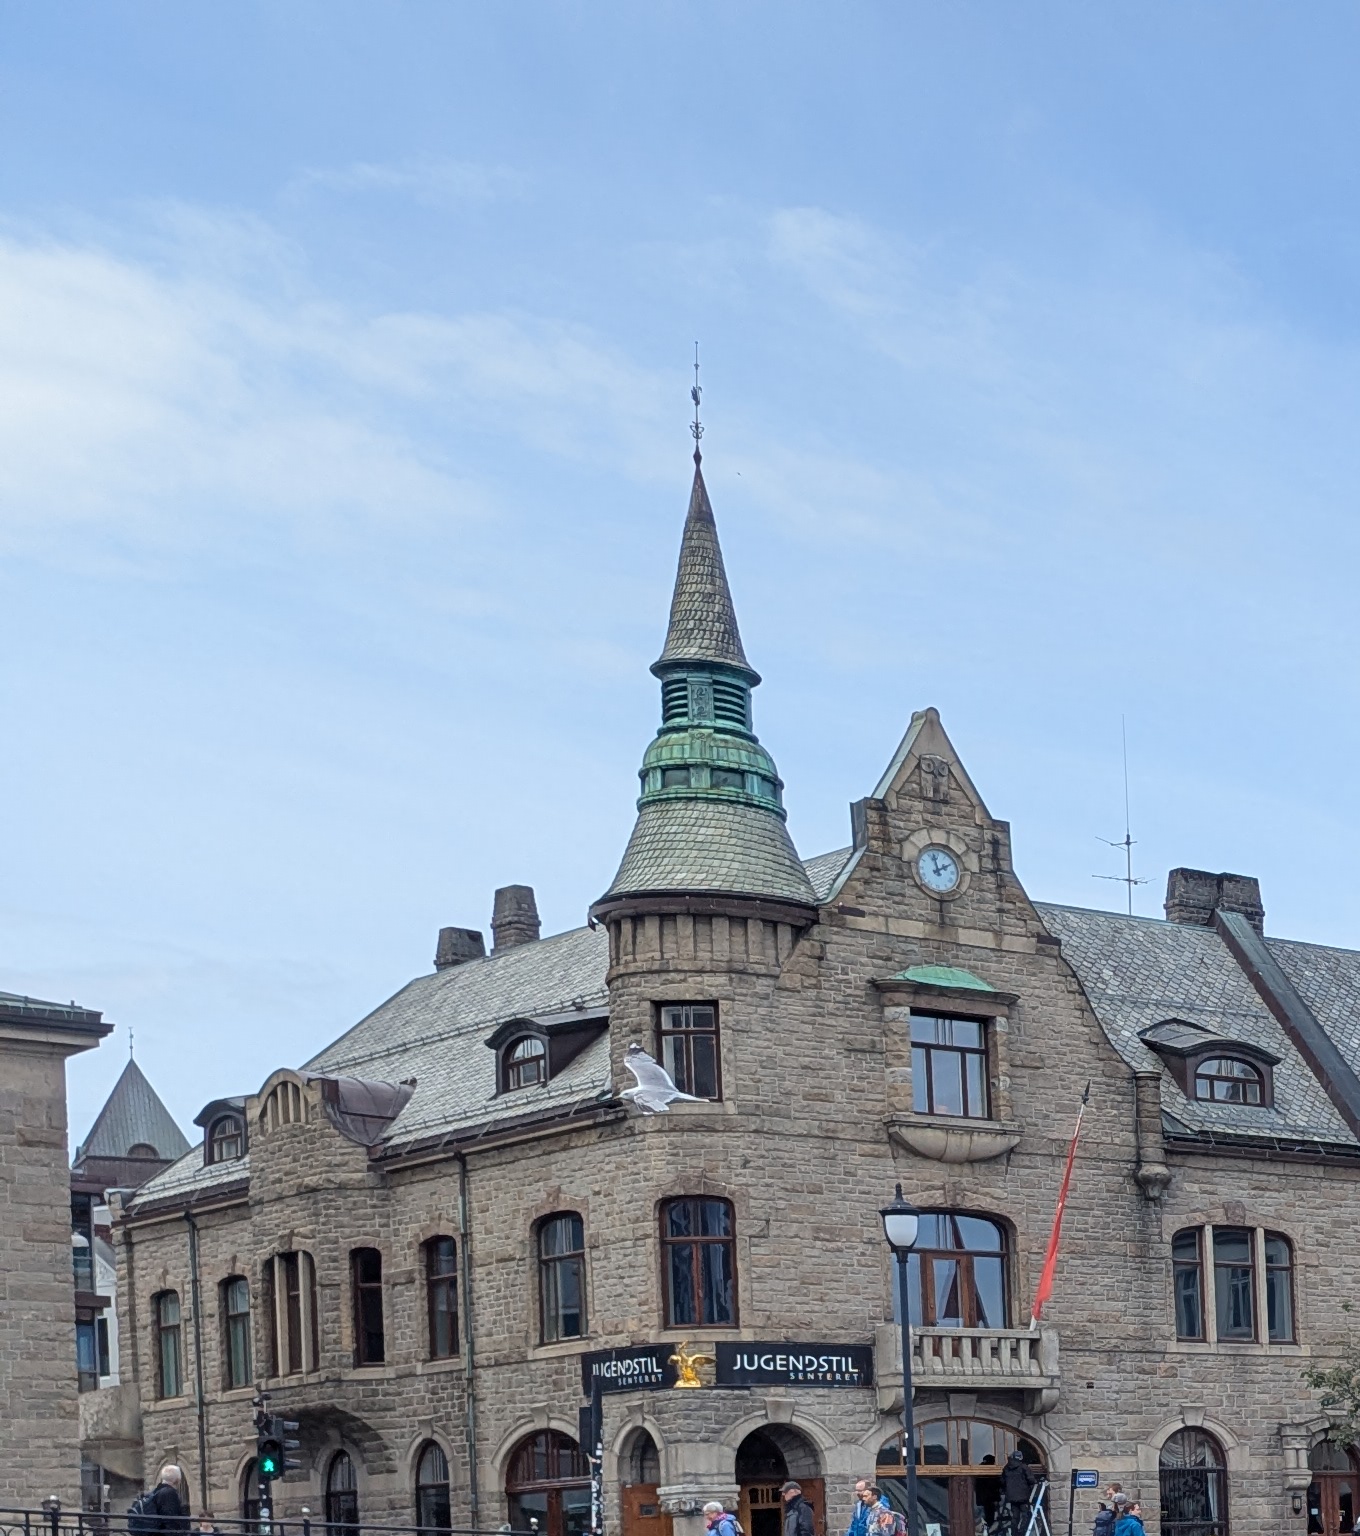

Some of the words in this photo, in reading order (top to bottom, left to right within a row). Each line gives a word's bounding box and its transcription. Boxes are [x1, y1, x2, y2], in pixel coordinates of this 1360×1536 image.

[733, 1354, 859, 1373] JUGENDSTIL
[618, 1374, 664, 1386] SENTERET
[789, 1372, 859, 1381] SENTERET
